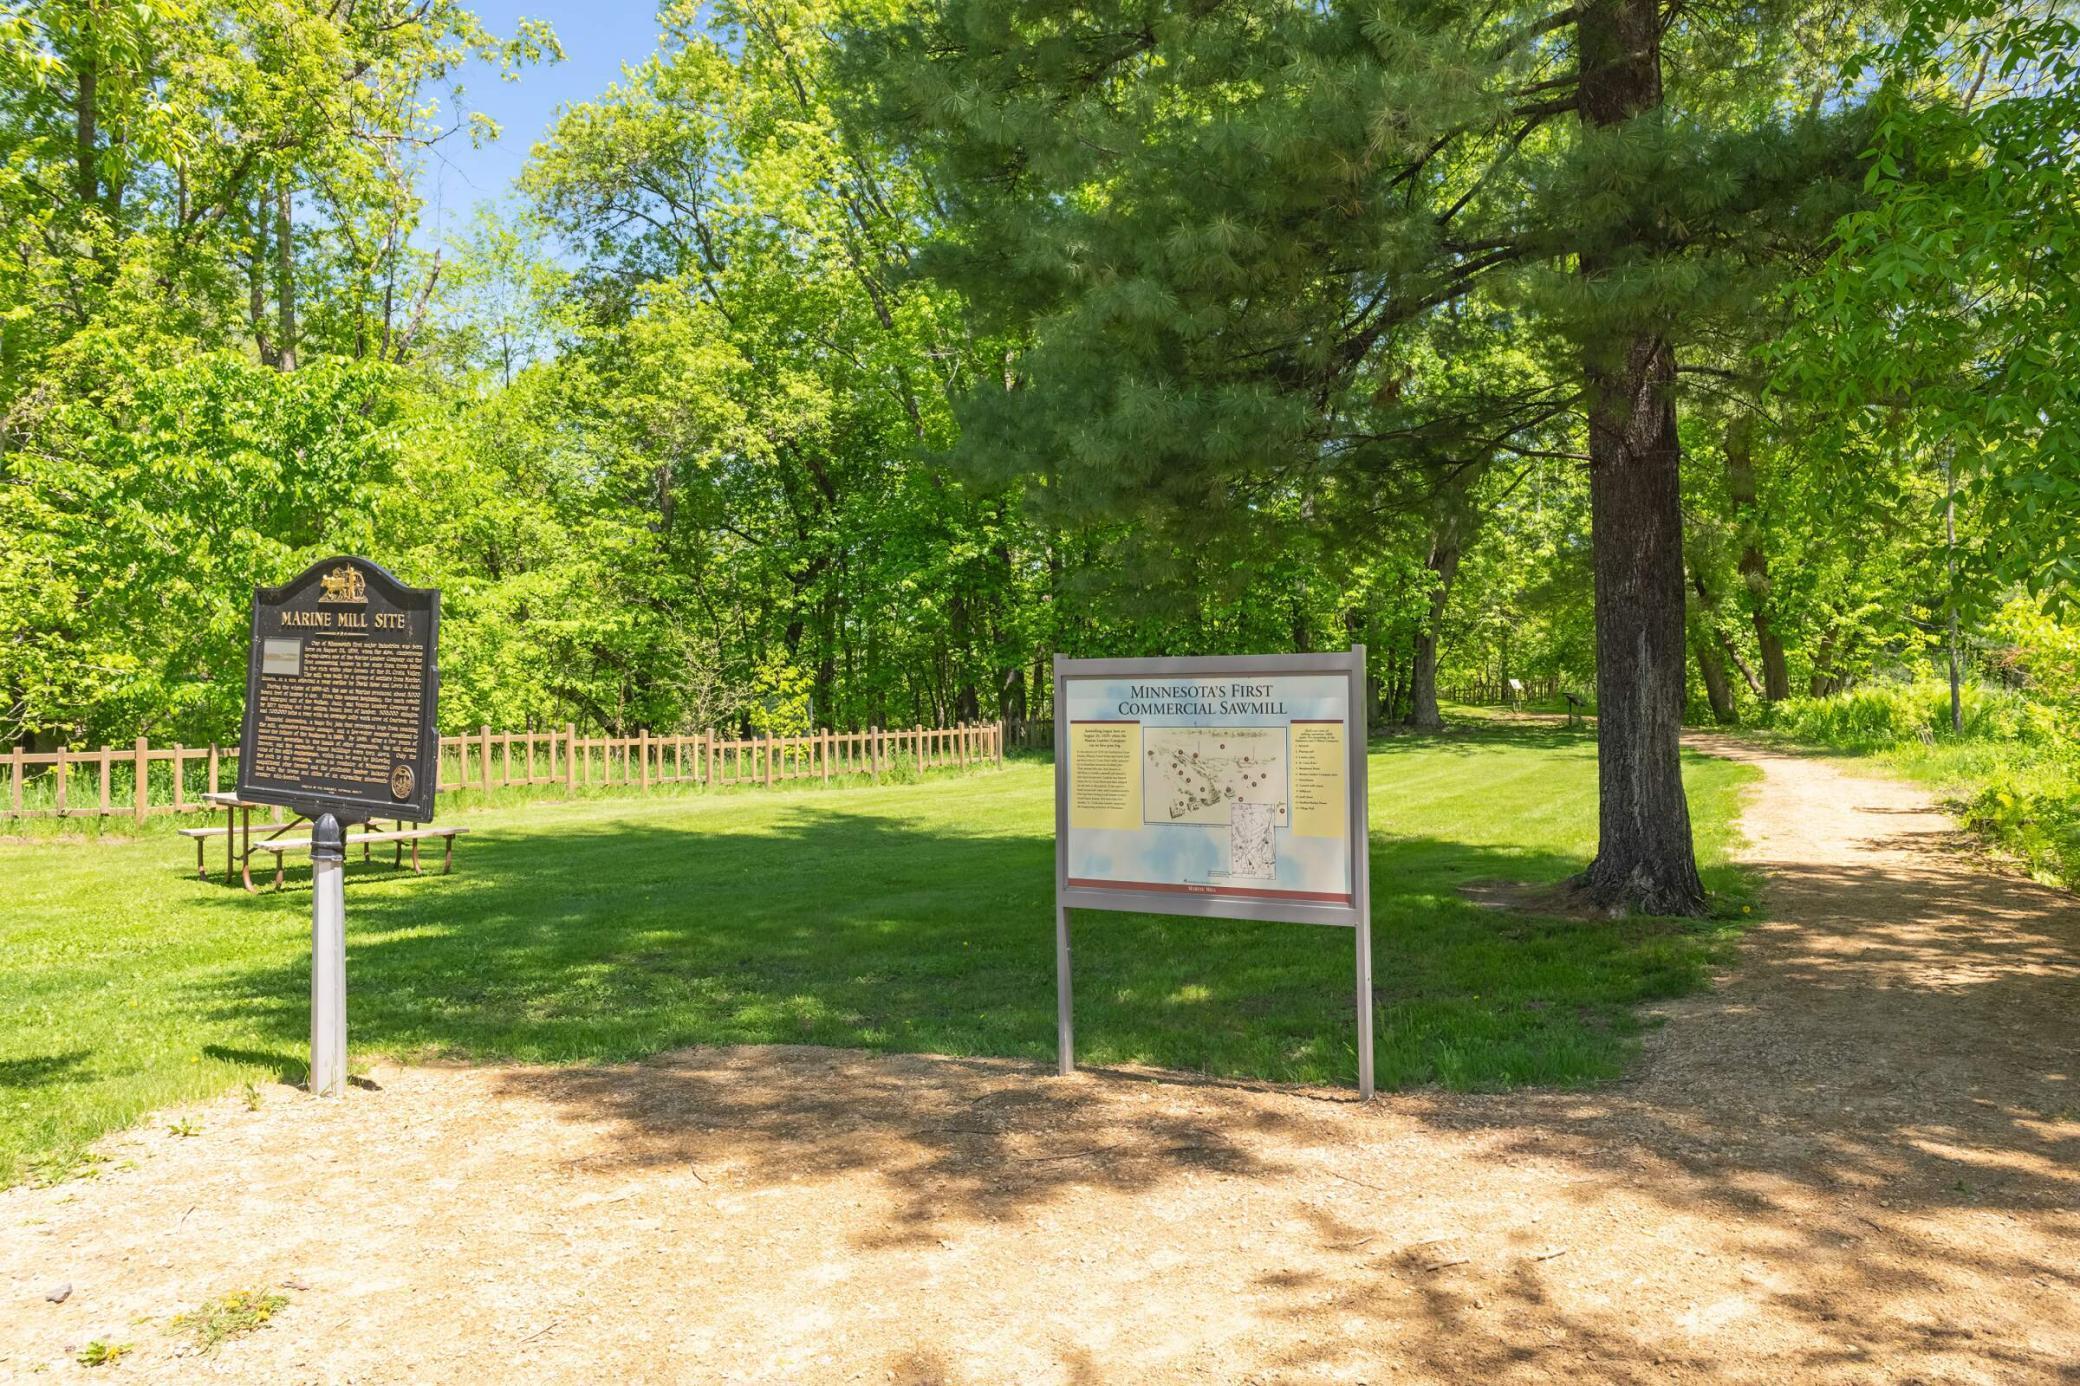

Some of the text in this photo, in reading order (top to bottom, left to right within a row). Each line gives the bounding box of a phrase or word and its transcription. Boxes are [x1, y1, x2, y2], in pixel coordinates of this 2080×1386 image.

[281, 611, 405, 629] MARINE MILL SITE
[1130, 684, 1274, 699] MINNESOTA'S FIRST
[1118, 701, 1288, 716] COMMERCIAL SAWMILL
